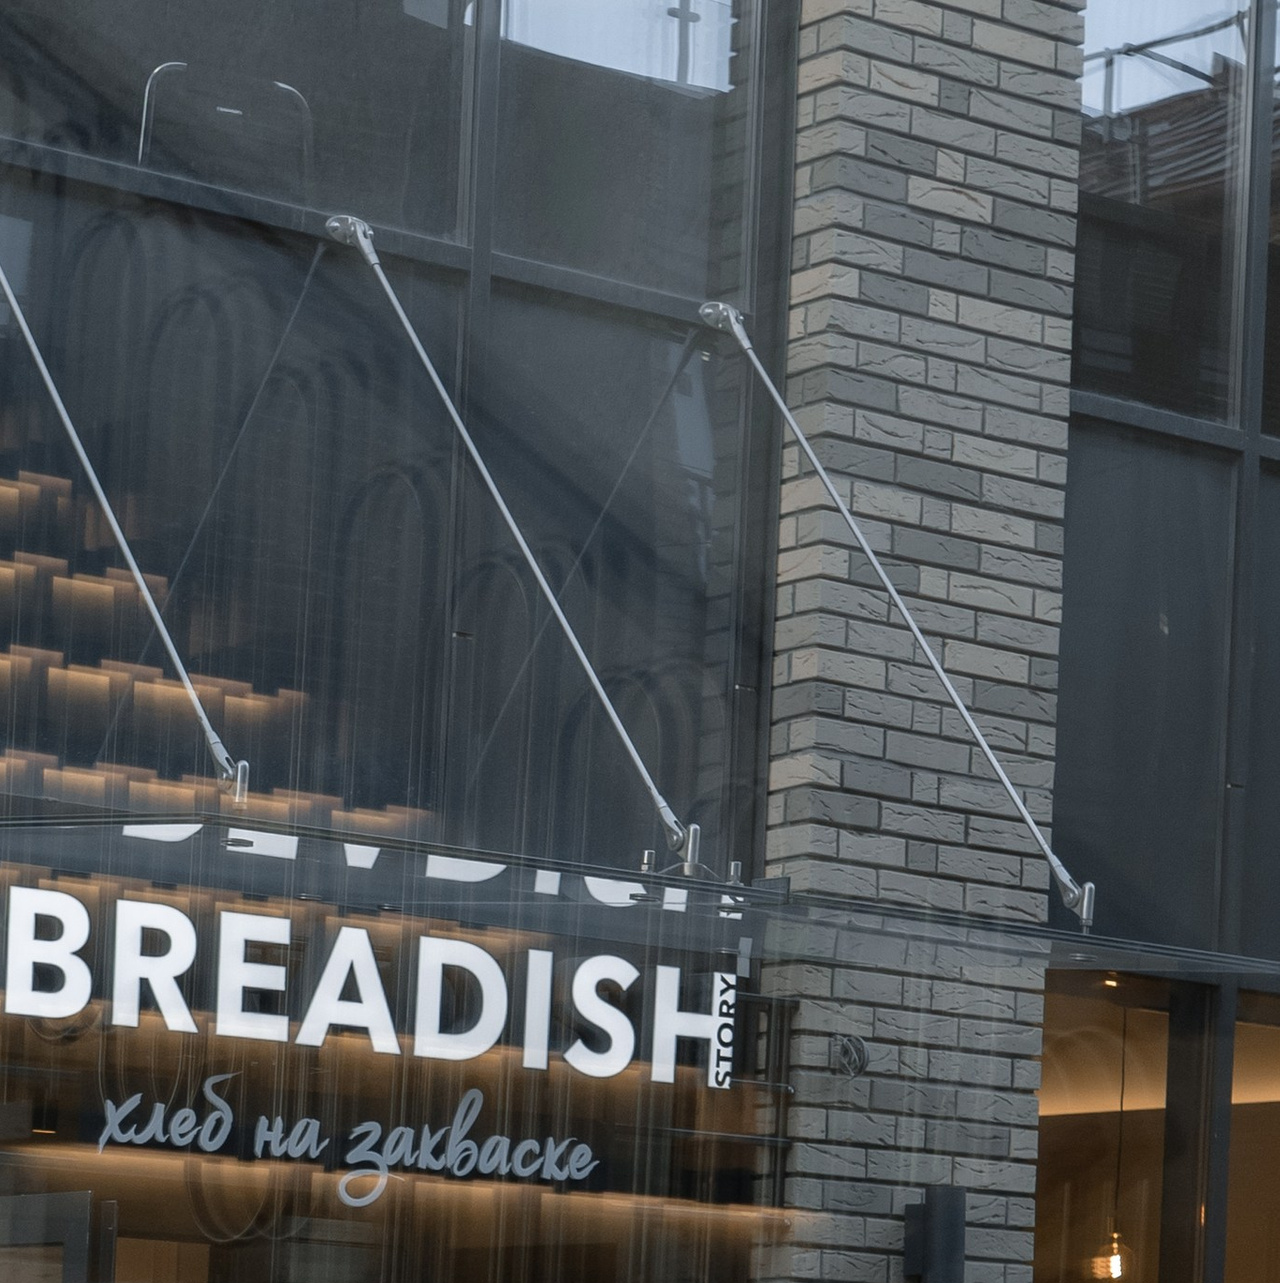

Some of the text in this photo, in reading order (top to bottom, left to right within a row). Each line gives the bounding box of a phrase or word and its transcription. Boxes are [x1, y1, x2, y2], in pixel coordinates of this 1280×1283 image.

[4, 885, 737, 1090] BREADISH
[714, 974, 737, 1089] STORY
[99, 1071, 598, 1207] хлеб на закваске
